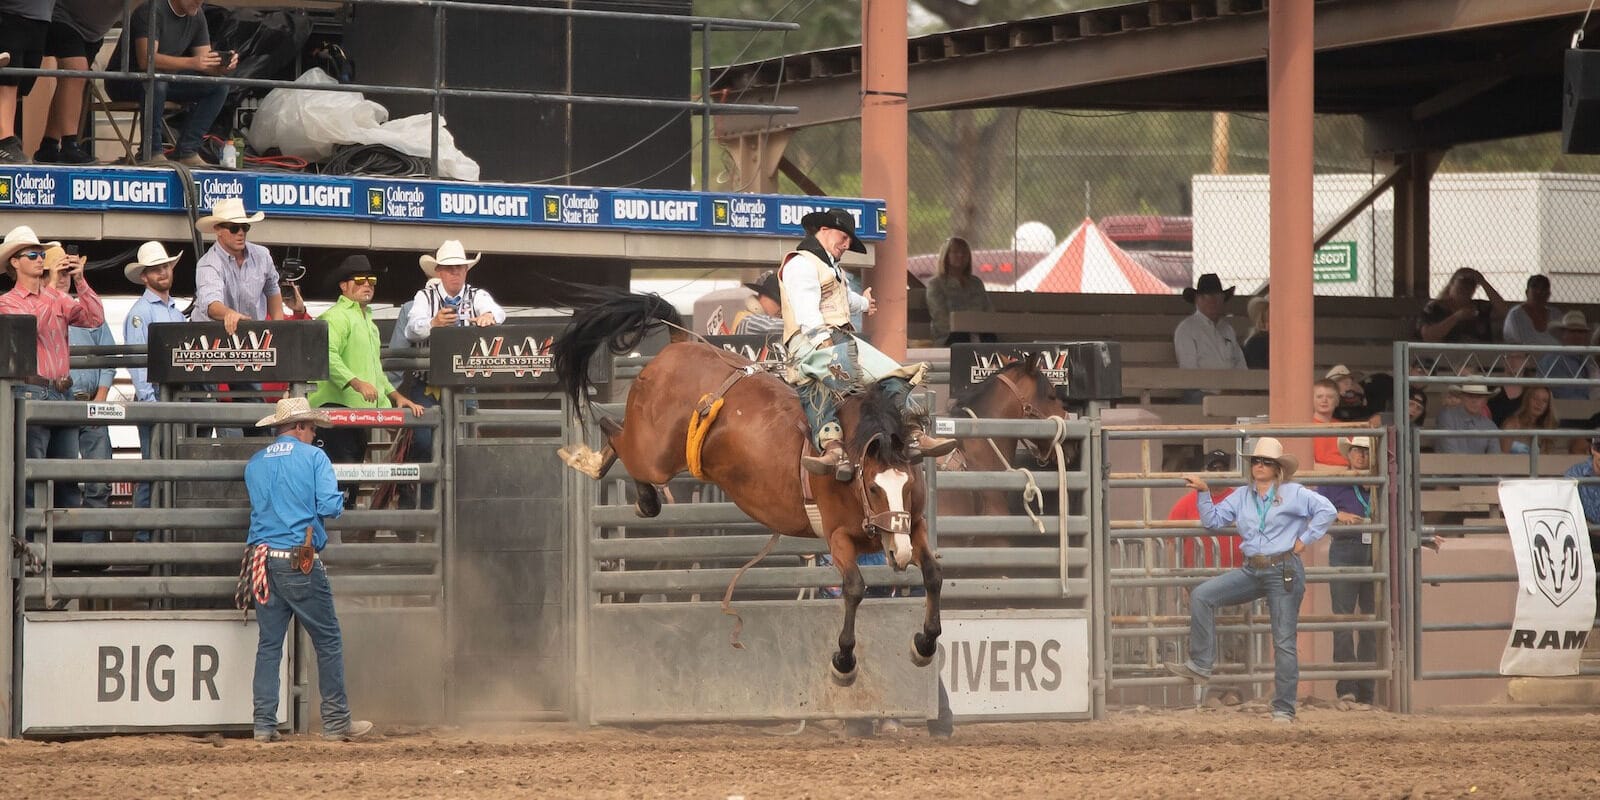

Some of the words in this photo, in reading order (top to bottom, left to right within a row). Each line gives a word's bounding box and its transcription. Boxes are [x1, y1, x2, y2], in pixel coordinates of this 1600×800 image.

[15, 173, 55, 190] Colorado
[203, 178, 243, 195] Colorado
[15, 189, 36, 205] State
[37, 190, 55, 205] Fair
[72, 179, 111, 201] BUD
[113, 181, 166, 203] LIGHT
[259, 184, 297, 205] BUD
[299, 185, 351, 208] LIGHT
[386, 186, 424, 203] Colorado
[386, 201, 407, 217] State
[408, 203, 425, 218] Fair
[440, 192, 477, 214] BUD
[479, 194, 528, 217] LIGHT
[562, 193, 599, 210] Colorado
[730, 198, 766, 214] Colorado
[562, 208, 582, 223] State
[583, 209, 599, 224] Fair
[613, 199, 650, 220] BUD
[651, 200, 698, 222] LIGHT
[730, 213, 750, 228] State
[750, 214, 766, 229] Fair
[175, 351, 226, 359] LIVESTOCK
[229, 351, 272, 359] SYSTEMS
[361, 467, 375, 478] State
[390, 467, 419, 477] RODEO
[1511, 629, 1589, 650] RAM
[97, 644, 176, 702] BIG
[192, 644, 221, 701] R
